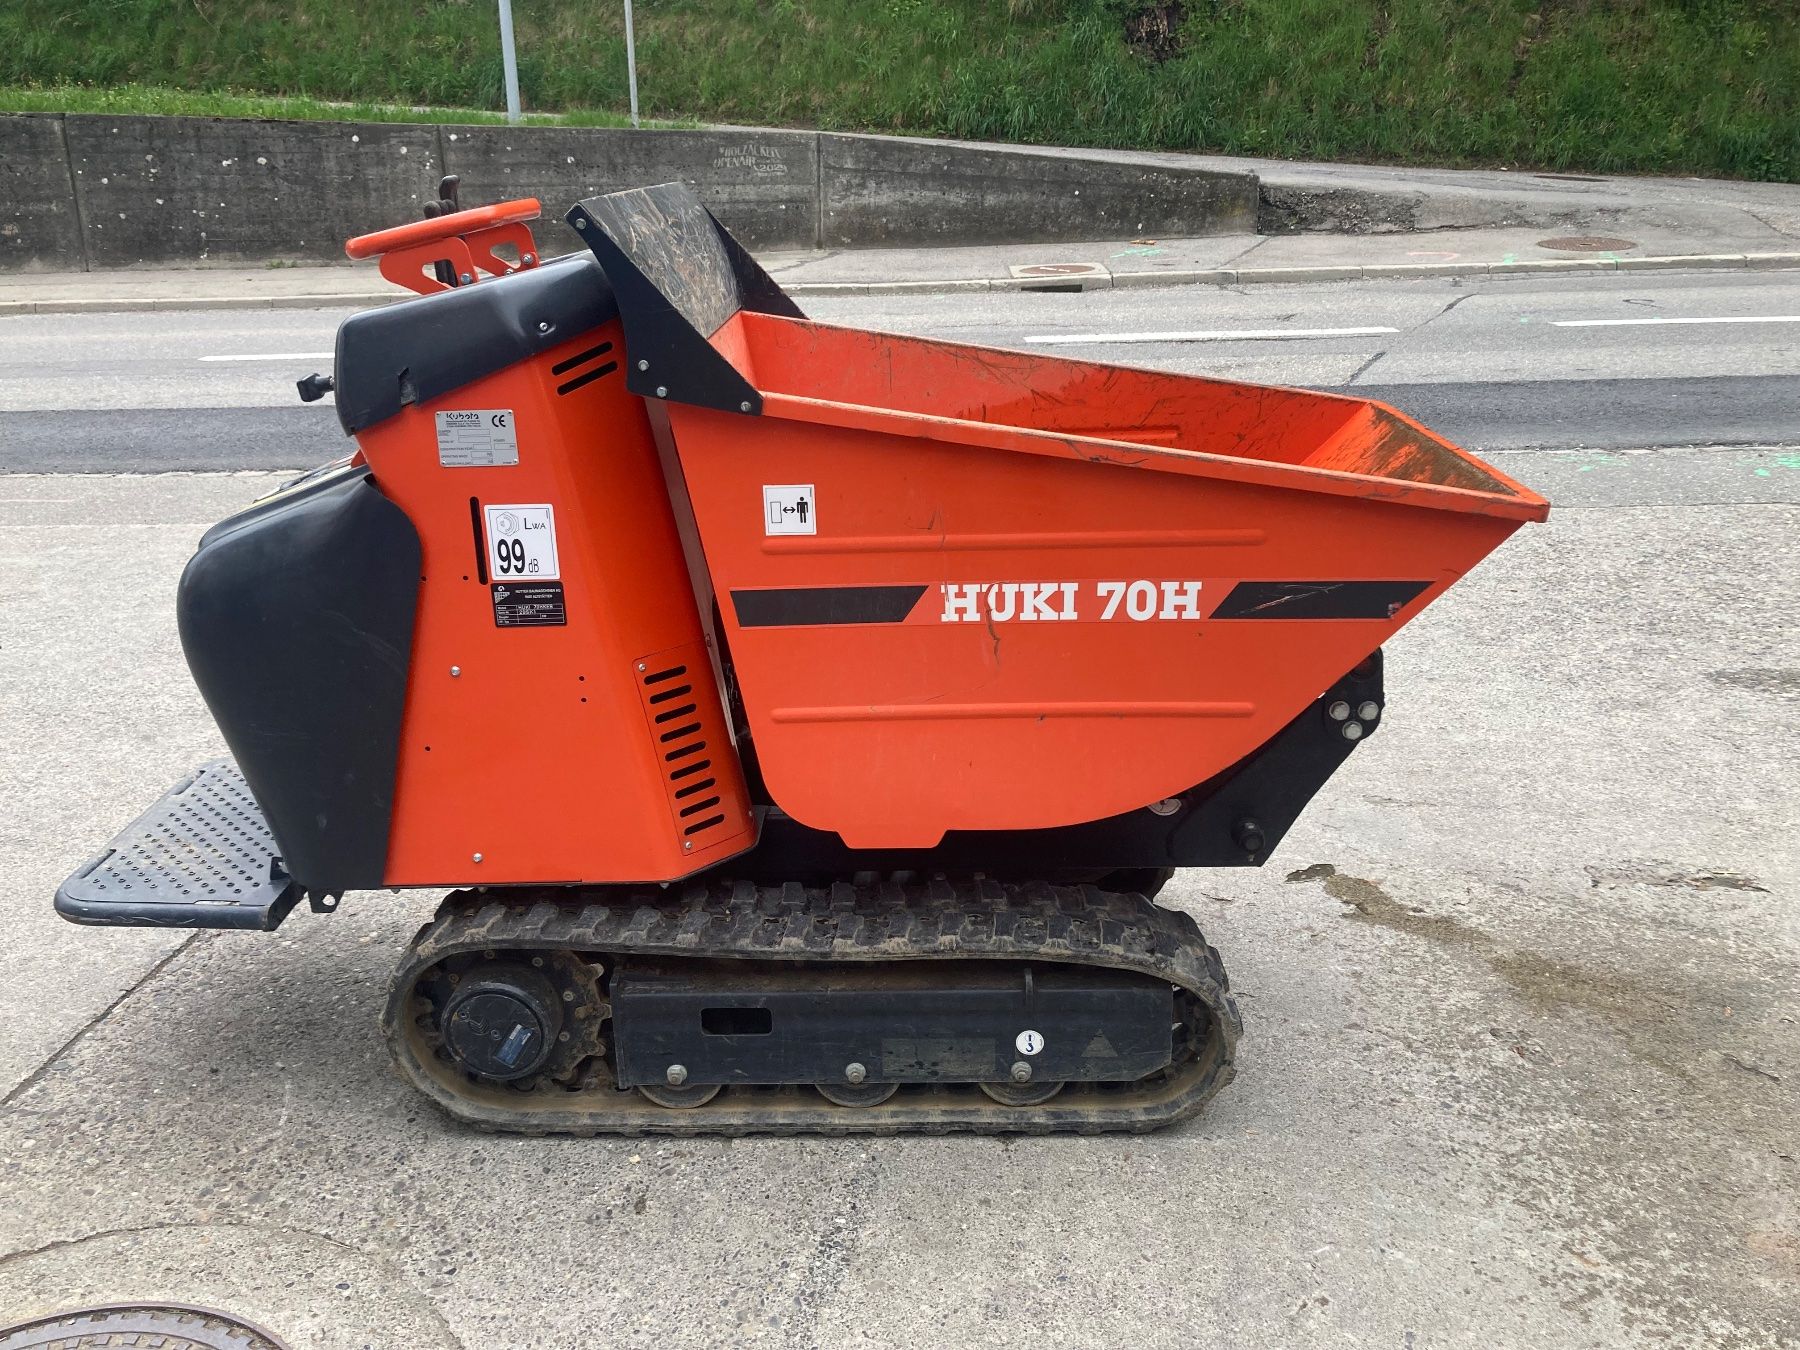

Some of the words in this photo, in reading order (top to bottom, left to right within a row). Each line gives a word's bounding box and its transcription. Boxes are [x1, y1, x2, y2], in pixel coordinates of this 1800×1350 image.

[446, 412, 480, 420] Kubota
[491, 414, 507, 428] CE
[497, 538, 526, 574] 99
[528, 558, 540, 573] dB
[941, 582, 1079, 622] HUKI
[1096, 579, 1203, 621] 70H
